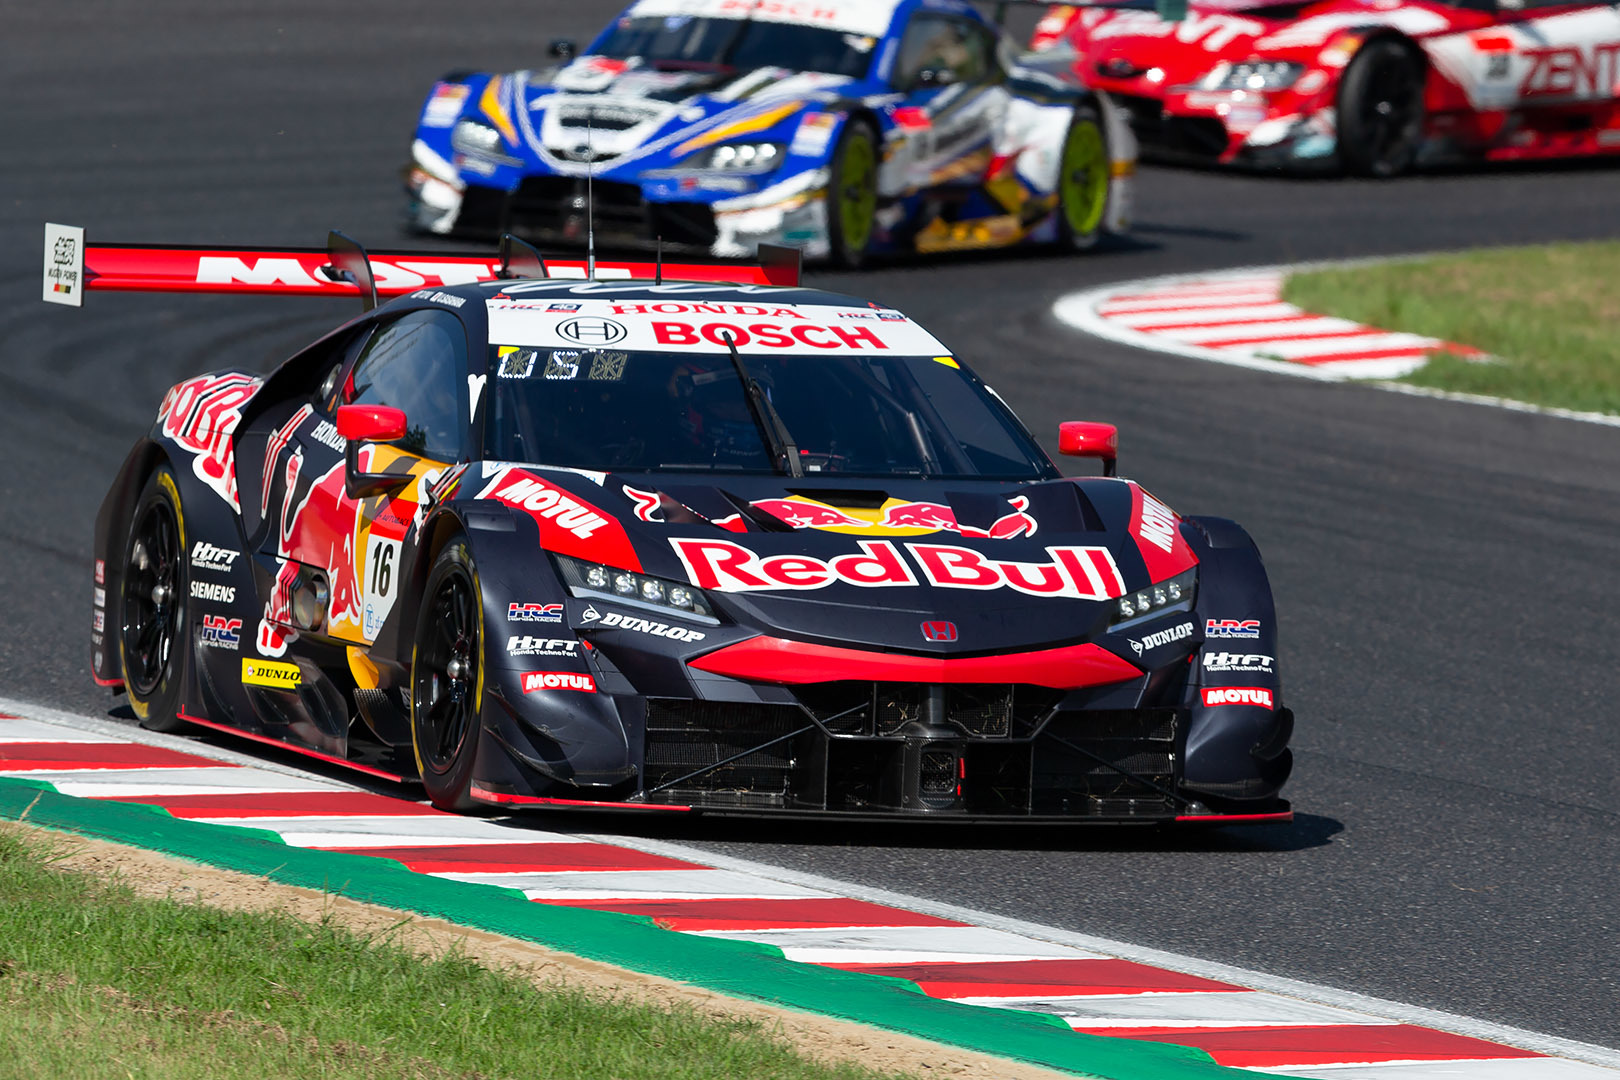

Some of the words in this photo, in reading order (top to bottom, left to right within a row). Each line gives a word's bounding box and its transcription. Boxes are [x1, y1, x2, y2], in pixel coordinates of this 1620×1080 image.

[196, 256, 632, 290] MOT
[609, 303, 811, 320] HONDA
[651, 321, 890, 348] BOSCH
[310, 420, 347, 453] HONDA
[495, 478, 609, 540] MOTUL
[1139, 493, 1175, 554] MOTU
[371, 541, 394, 598] 16
[667, 537, 920, 593] Red
[903, 542, 1127, 601] Bull
[190, 581, 236, 603] SIEMENS
[508, 603, 564, 620] HRC
[202, 614, 243, 643] HRC
[600, 612, 706, 643] DUNLOP
[1142, 622, 1194, 650] DUNLOP
[1205, 619, 1260, 635] HRC
[256, 667, 301, 681] DUNLO
[525, 674, 594, 690] MOTUL
[1206, 689, 1272, 707] MOTUL
